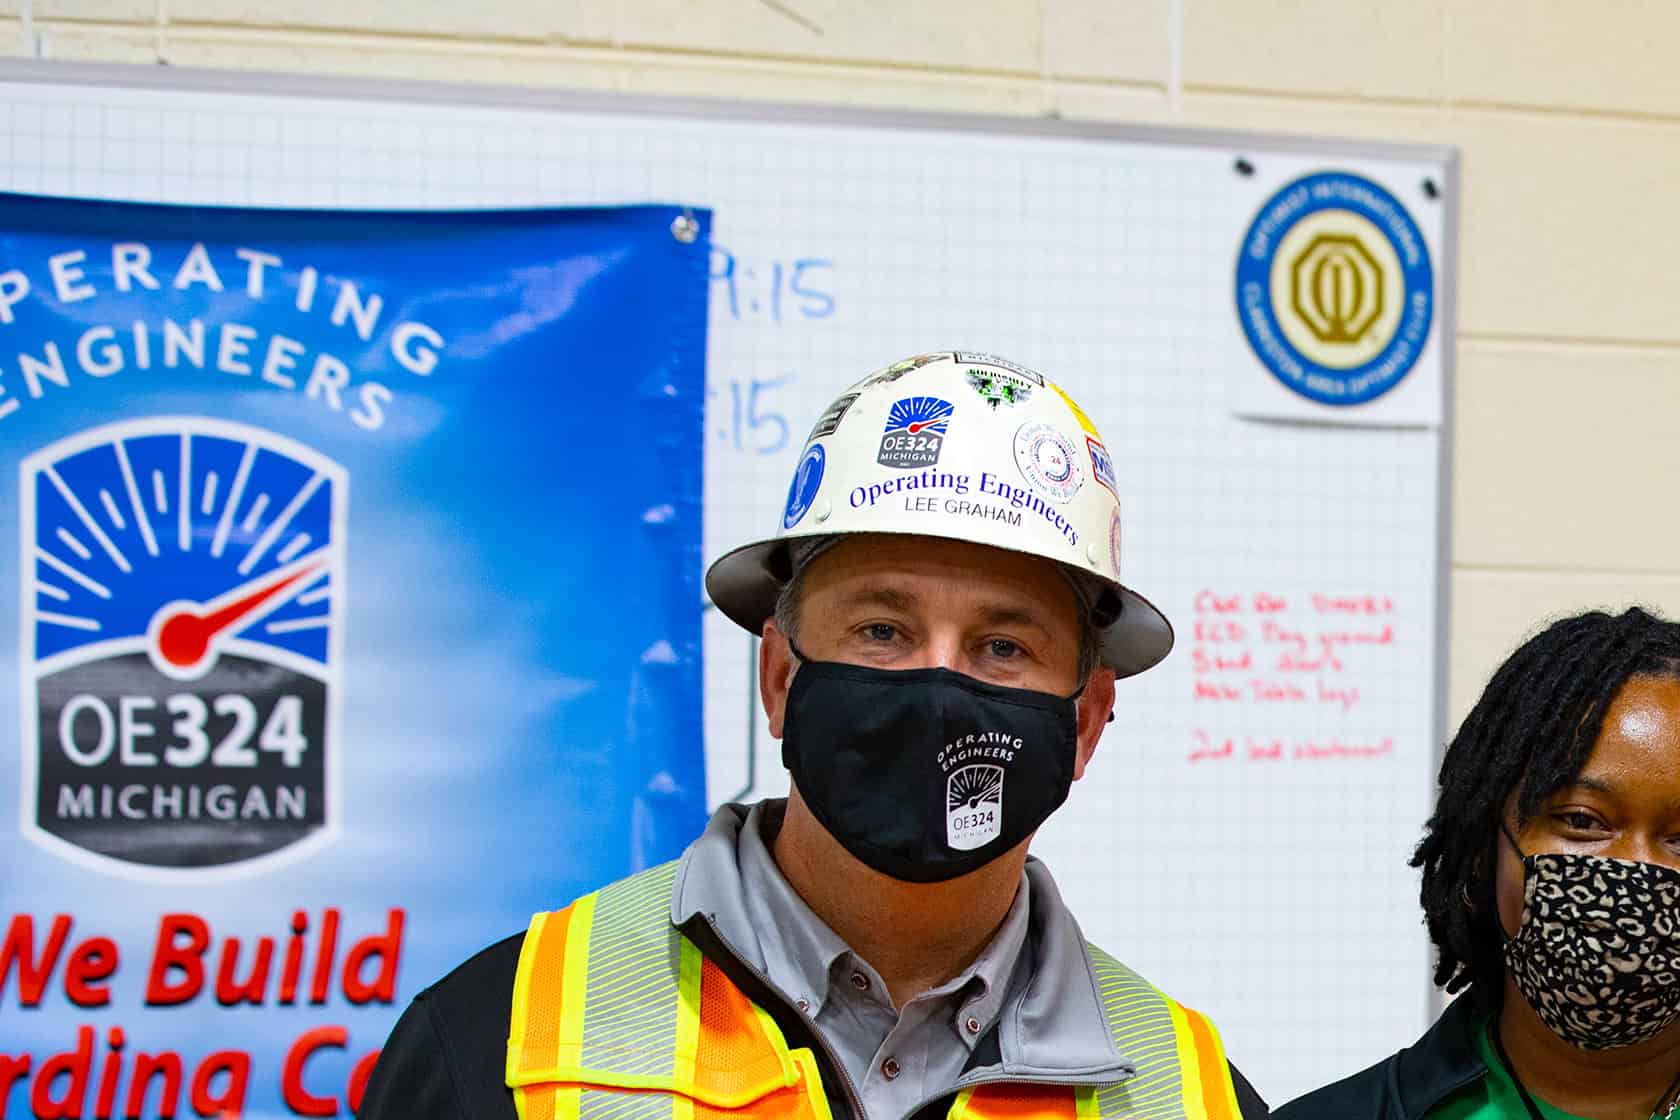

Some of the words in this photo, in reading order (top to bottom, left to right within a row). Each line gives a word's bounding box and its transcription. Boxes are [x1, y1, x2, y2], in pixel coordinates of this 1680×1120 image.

[880, 453, 937, 463] MICHIGAN
[883, 437, 939, 452] OE324
[849, 468, 970, 508] Operating
[979, 471, 1080, 547] Engineers
[905, 497, 938, 512] LEE
[944, 498, 1023, 527] GRAHAM
[58, 693, 308, 768] OE324
[937, 732, 1023, 763] OPERATING
[942, 748, 1015, 772] ENGINEERS
[57, 784, 307, 820] MICHIGAN
[953, 811, 994, 831] OE324
[0, 914, 118, 1008] We
[144, 907, 406, 1007] Build
